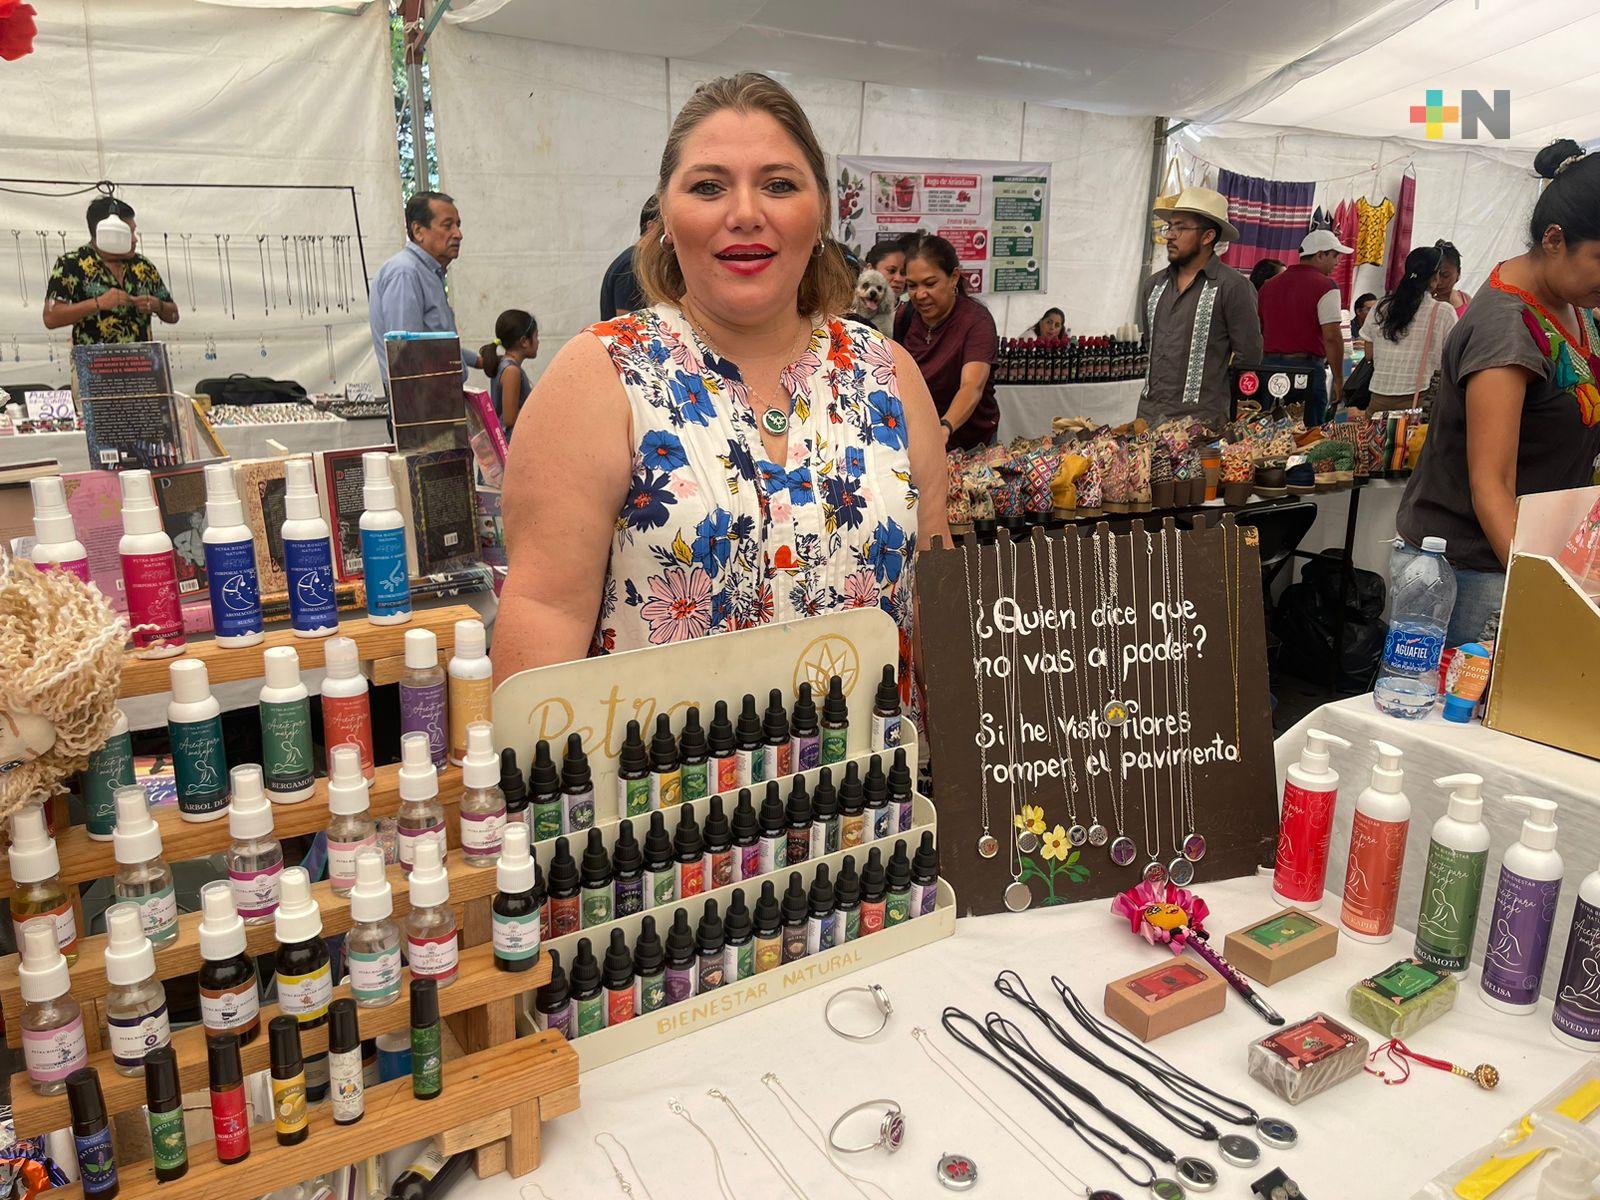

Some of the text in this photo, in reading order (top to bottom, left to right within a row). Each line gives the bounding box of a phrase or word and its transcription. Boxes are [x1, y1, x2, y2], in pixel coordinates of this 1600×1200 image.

[976, 597, 1197, 638] ¿Quien dice que
[974, 624, 1207, 682] no vas a poder?
[1395, 644, 1427, 659] AGUAFIEL
[1457, 668, 1489, 681] orporal
[1461, 663, 1490, 675] Crema
[267, 719, 292, 733] Aceite
[975, 712, 1005, 748] Si
[1020, 713, 1047, 744] he
[1123, 700, 1191, 741] flores
[179, 737, 207, 753] Aceite
[982, 732, 1238, 788] romper el pavimento
[1447, 868, 1470, 883] para
[1514, 896, 1537, 912] para
[656, 948, 862, 1036] BIENESTAR NATURAL
[1483, 977, 1511, 998] MELISA
